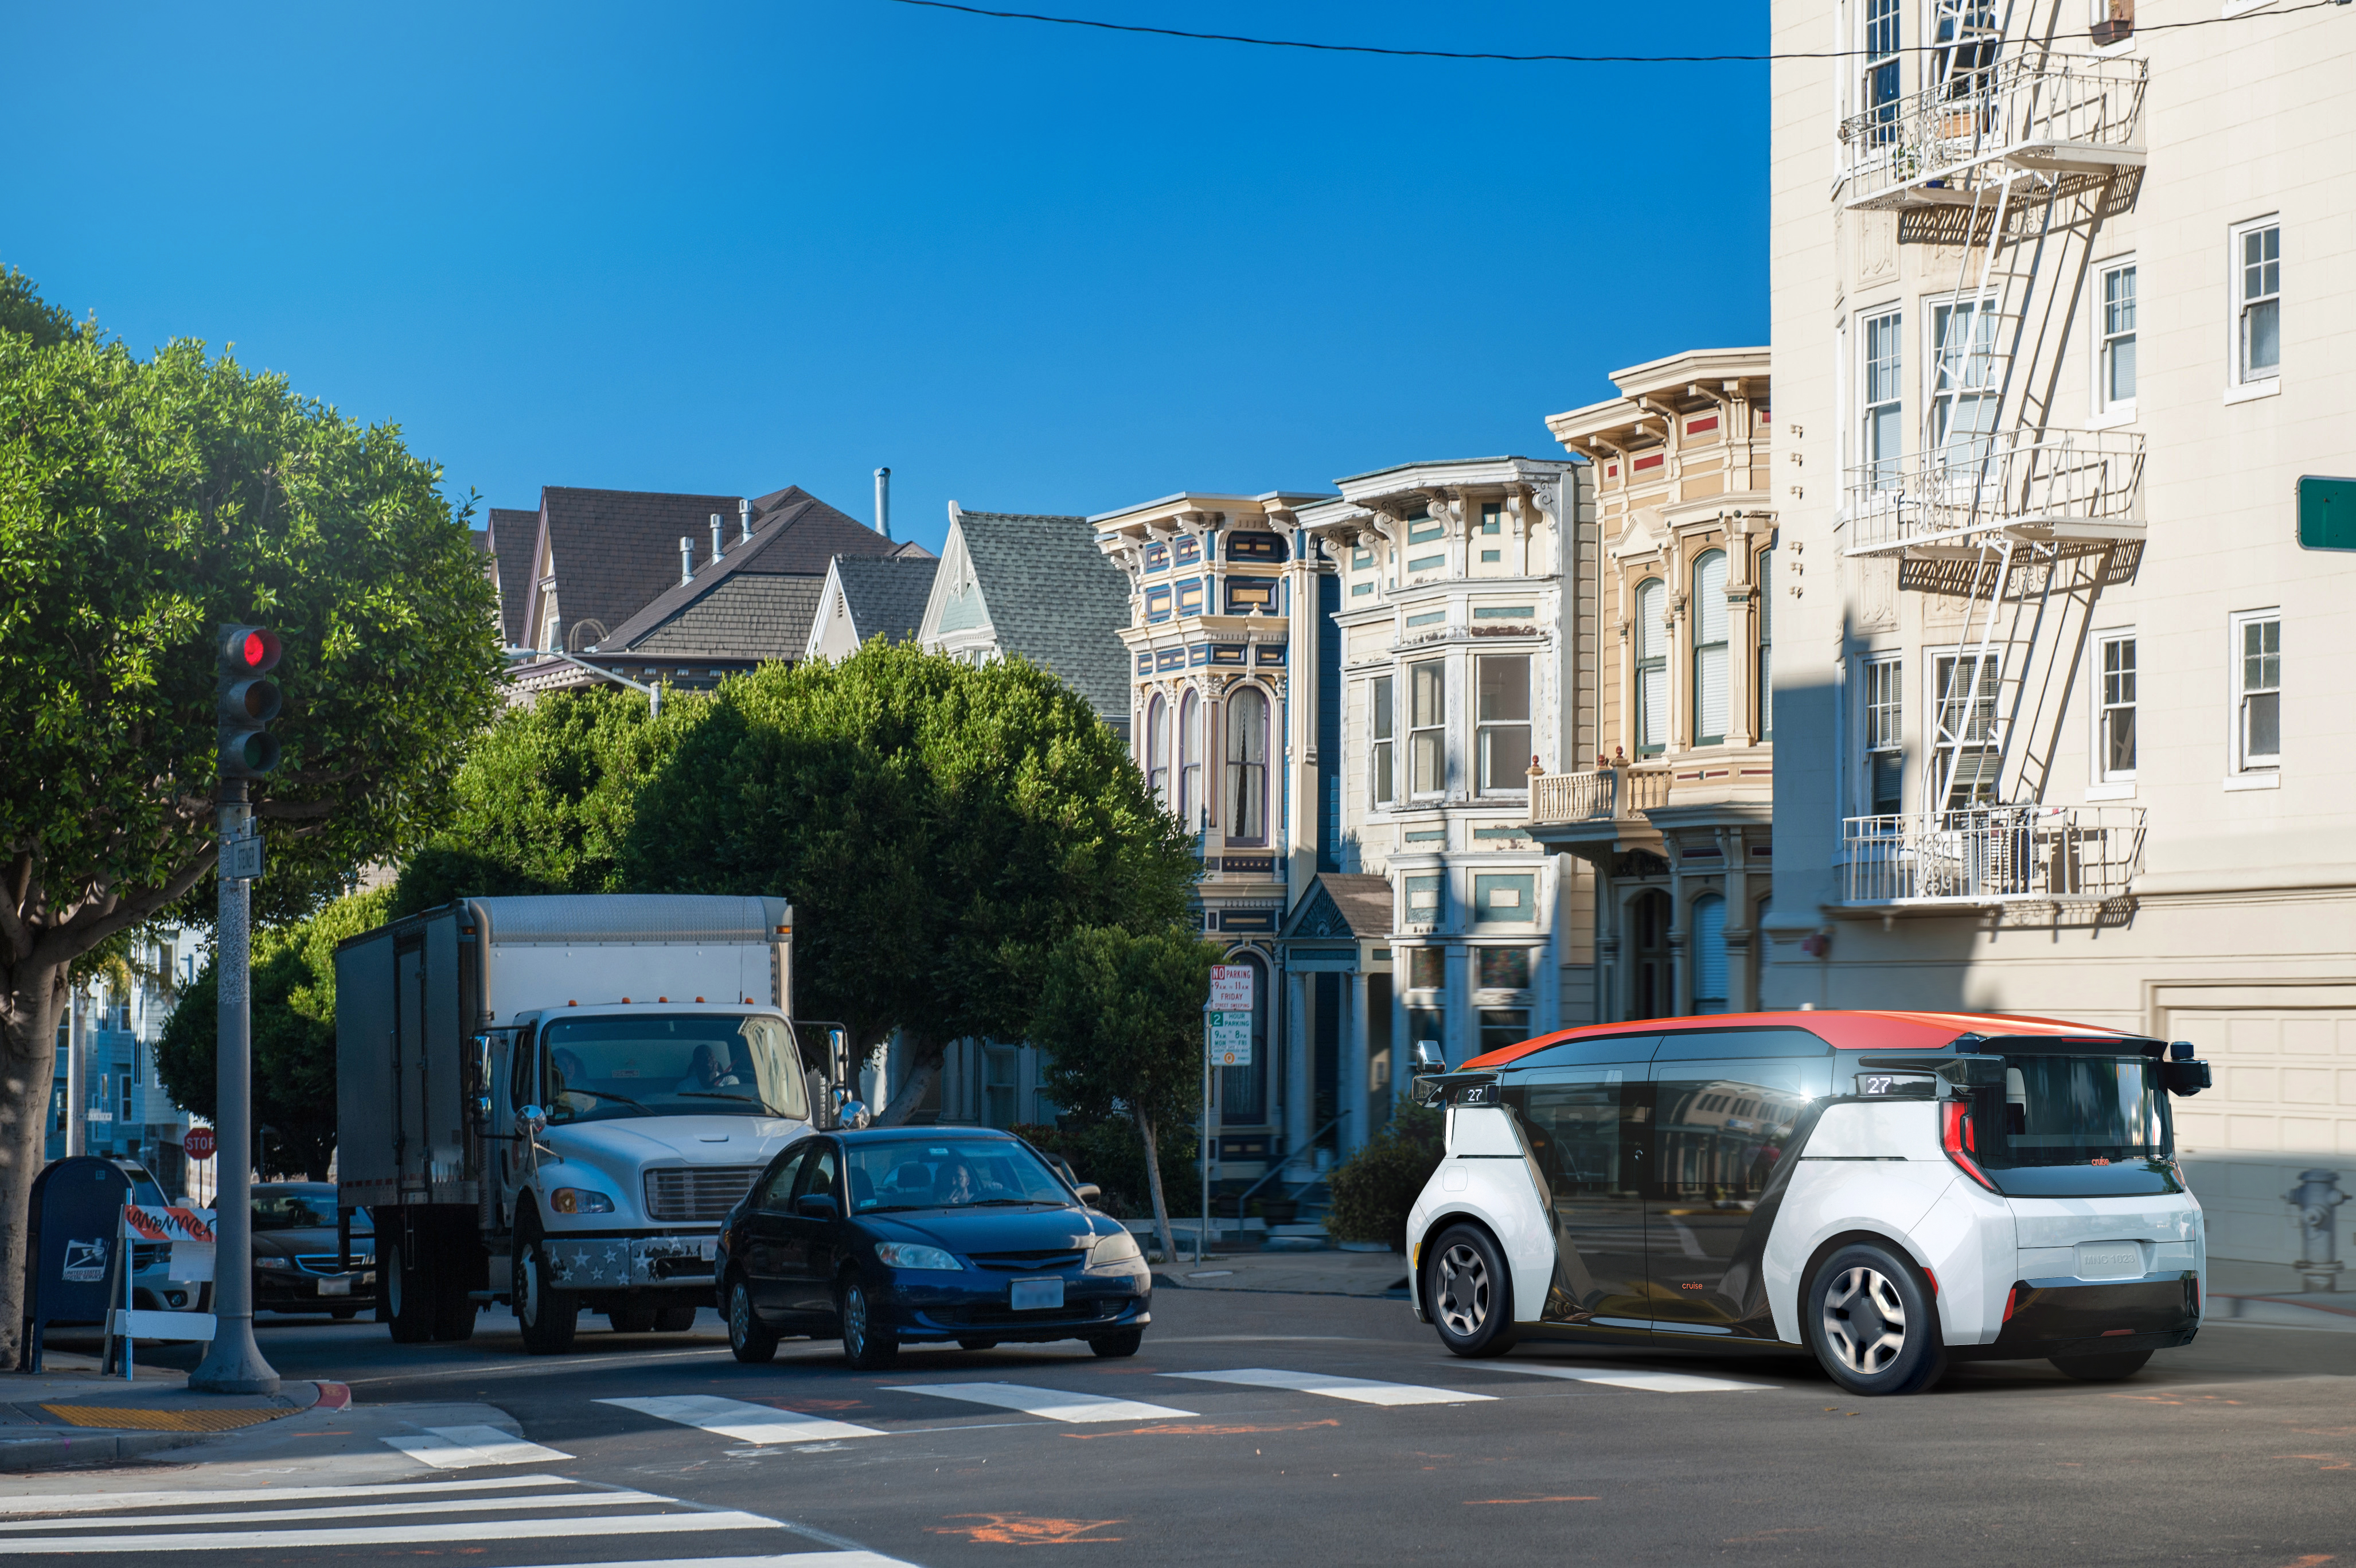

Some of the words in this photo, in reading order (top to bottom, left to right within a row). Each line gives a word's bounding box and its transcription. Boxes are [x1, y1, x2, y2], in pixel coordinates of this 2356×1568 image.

[1213, 968, 1224, 978] NO
[1226, 970, 1251, 979] PARKING
[1214, 1014, 1221, 1025] 2
[1868, 1078, 1891, 1093] 27
[1468, 1089, 1483, 1101] 27
[2092, 1156, 2109, 1166] cruise
[2085, 1255, 2108, 1264] MNC
[2111, 1254, 2135, 1263] 1023
[1682, 1281, 1703, 1289] cruise
